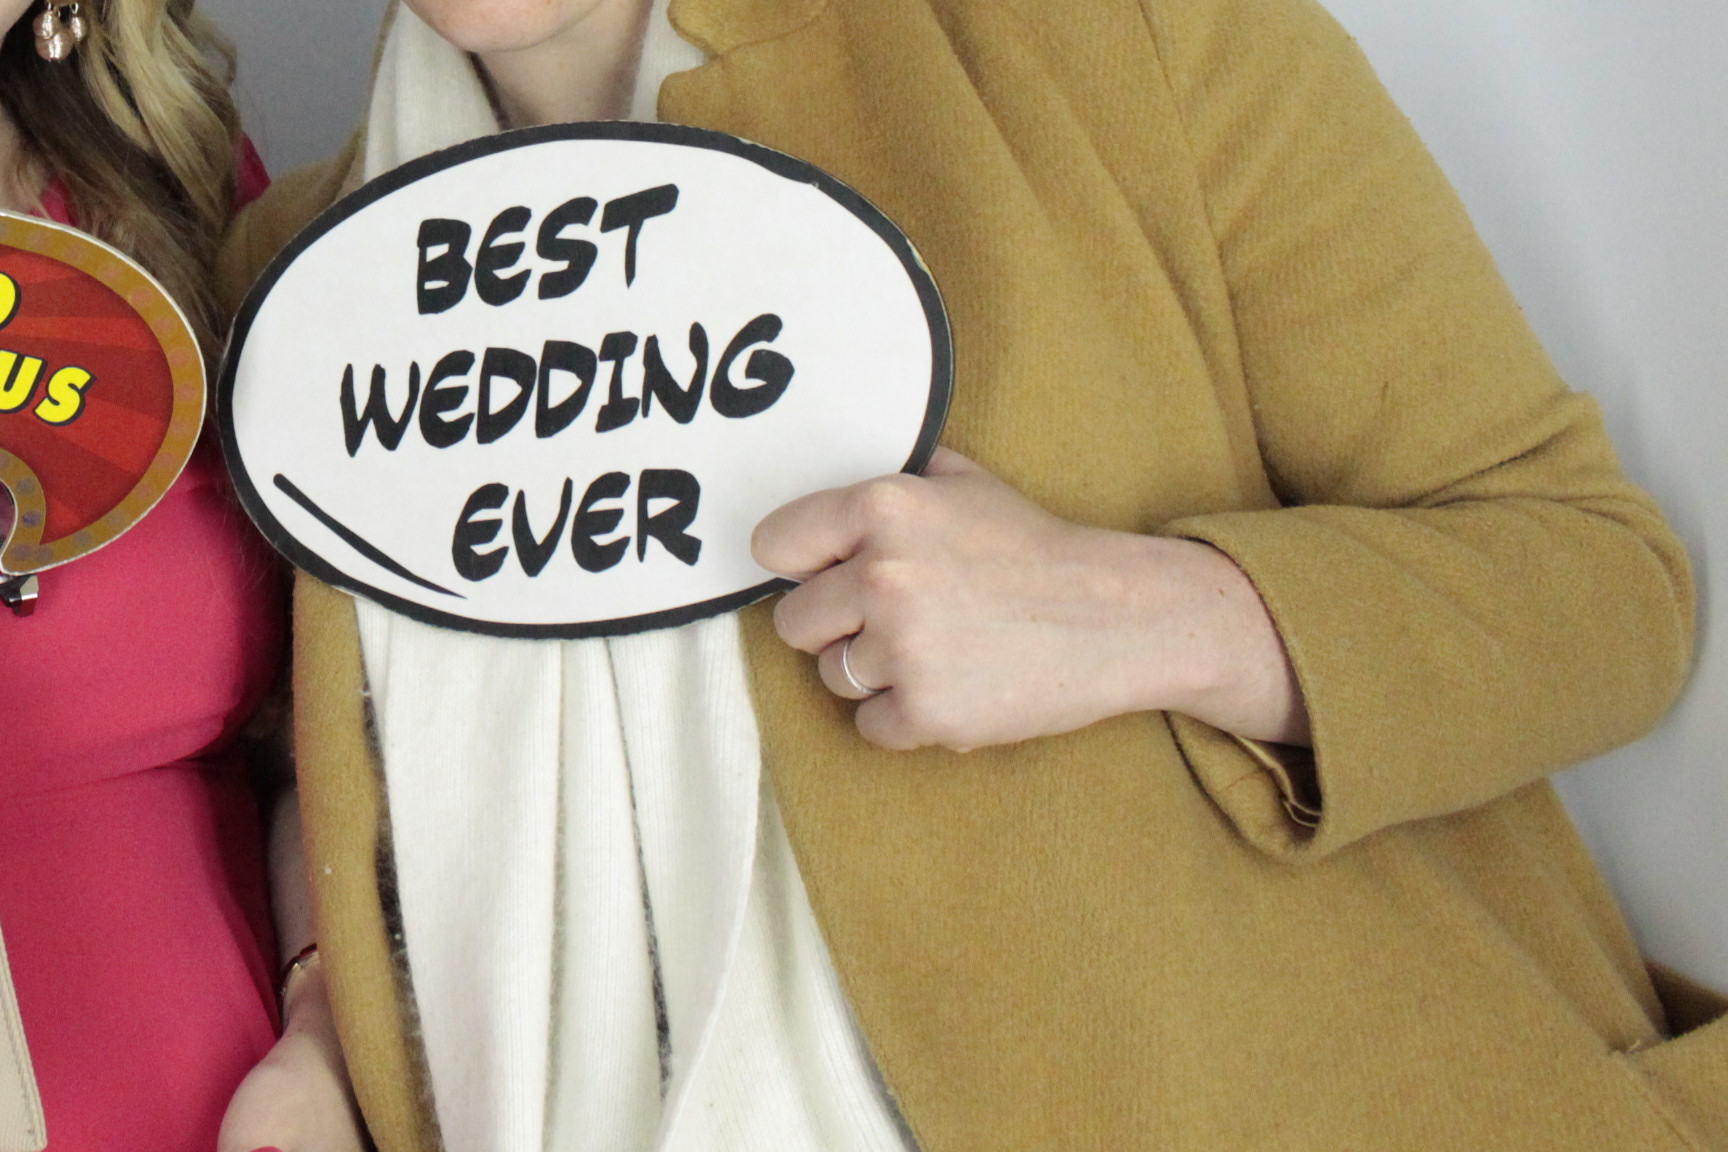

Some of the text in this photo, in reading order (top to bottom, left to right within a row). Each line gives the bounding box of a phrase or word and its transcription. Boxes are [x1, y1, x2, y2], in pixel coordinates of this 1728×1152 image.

[417, 183, 679, 314] BEST
[340, 313, 795, 457] WEDDING
[452, 469, 703, 581] EVER
